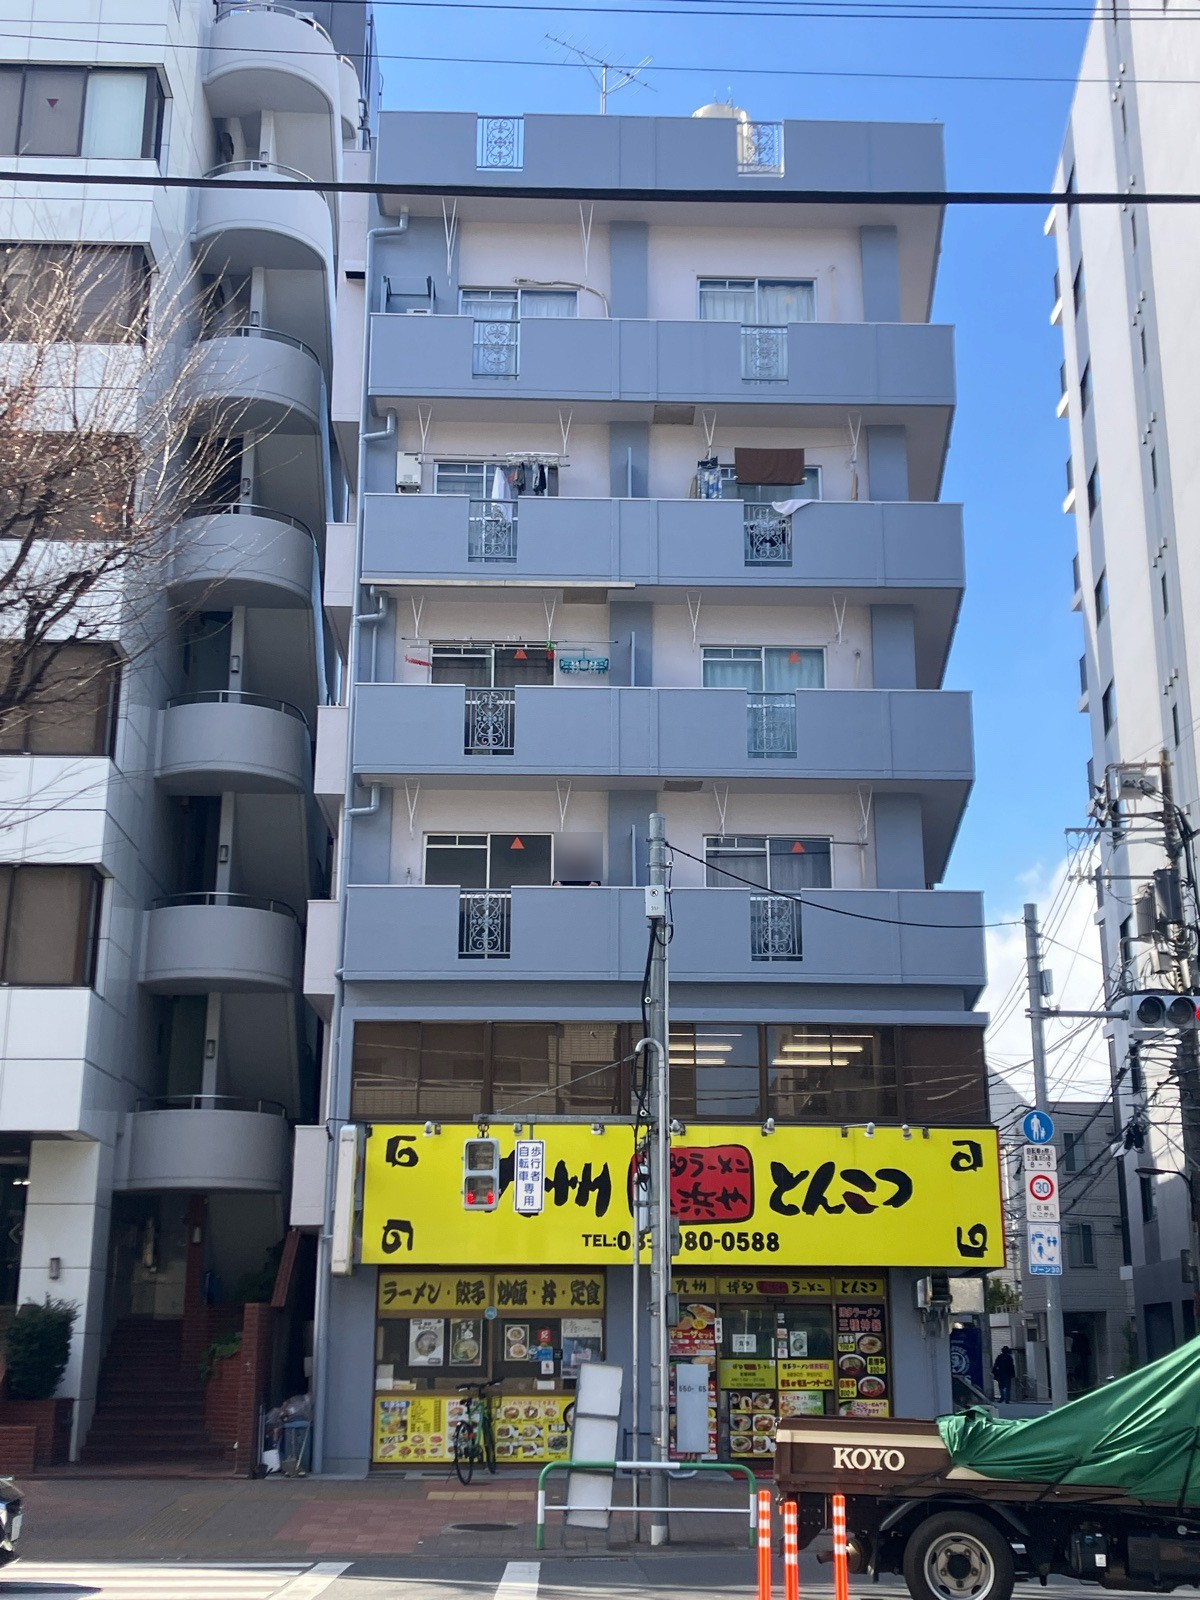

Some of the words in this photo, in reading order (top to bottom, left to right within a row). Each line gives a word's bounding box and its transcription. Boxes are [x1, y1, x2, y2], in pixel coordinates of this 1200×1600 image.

[518, 1146, 529, 1181] 自転車
[530, 1146, 541, 1181] 歩行者
[523, 1183, 535, 1207] 専用
[770, 1161, 913, 1216] とんこつ
[1035, 1182, 1049, 1194] 30
[675, 1279, 707, 1293] 九州
[791, 1281, 825, 1294] ラーメン
[841, 1280, 877, 1294] とんこつ
[833, 1447, 905, 1471] KOYO
